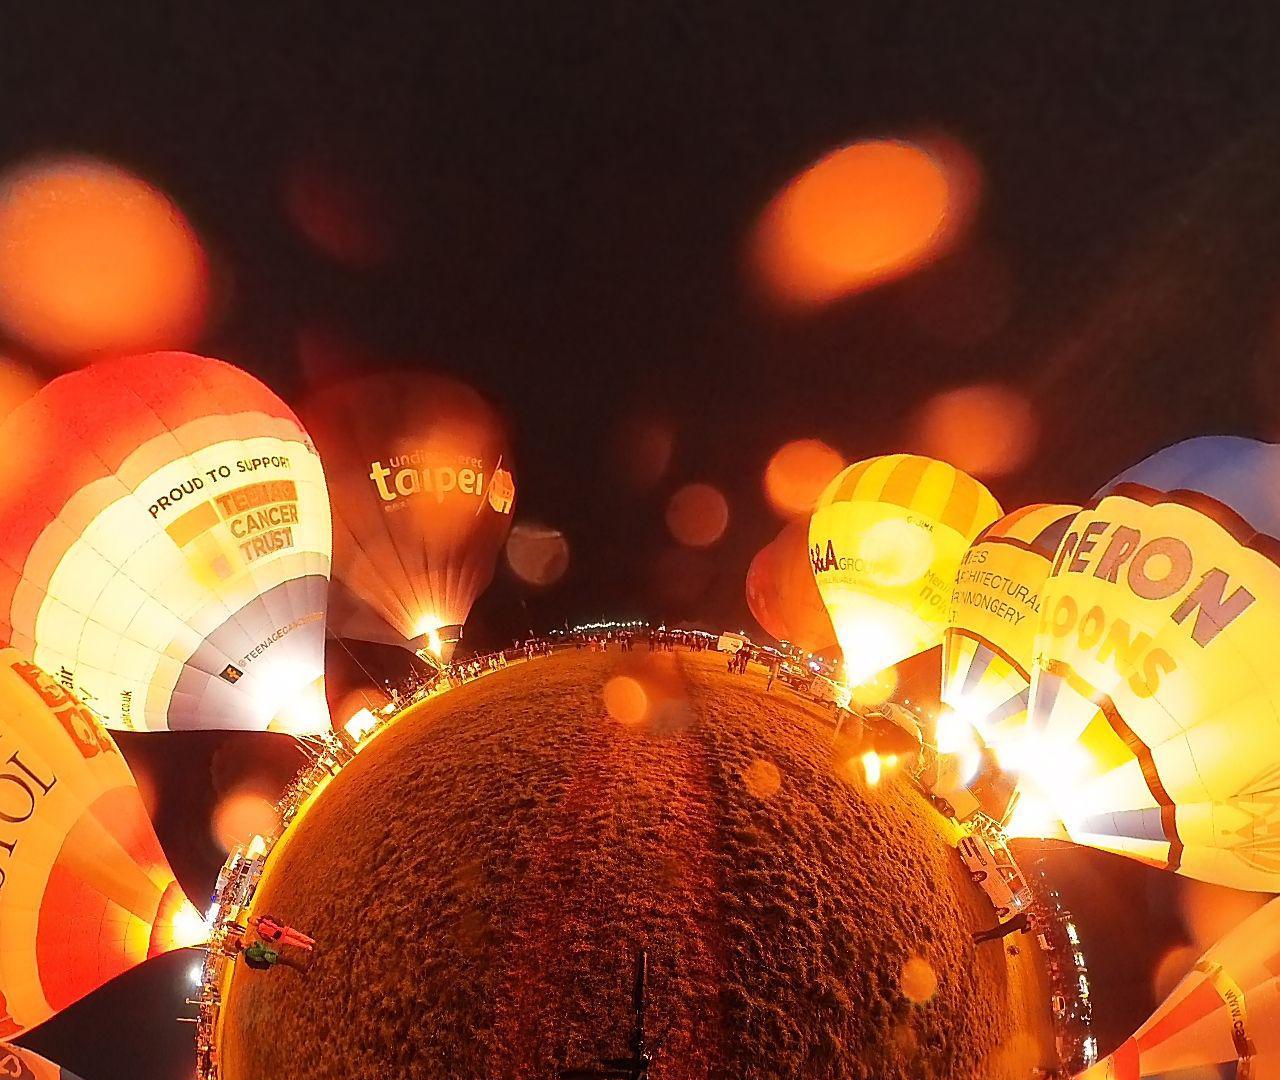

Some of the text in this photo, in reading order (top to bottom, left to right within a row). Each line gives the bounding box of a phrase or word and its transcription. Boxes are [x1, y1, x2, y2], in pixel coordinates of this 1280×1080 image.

[148, 455, 291, 519] PROUD TO SUPPORT
[369, 461, 484, 504] taipei
[229, 504, 299, 539] CANCER
[239, 527, 294, 561] TRUST
